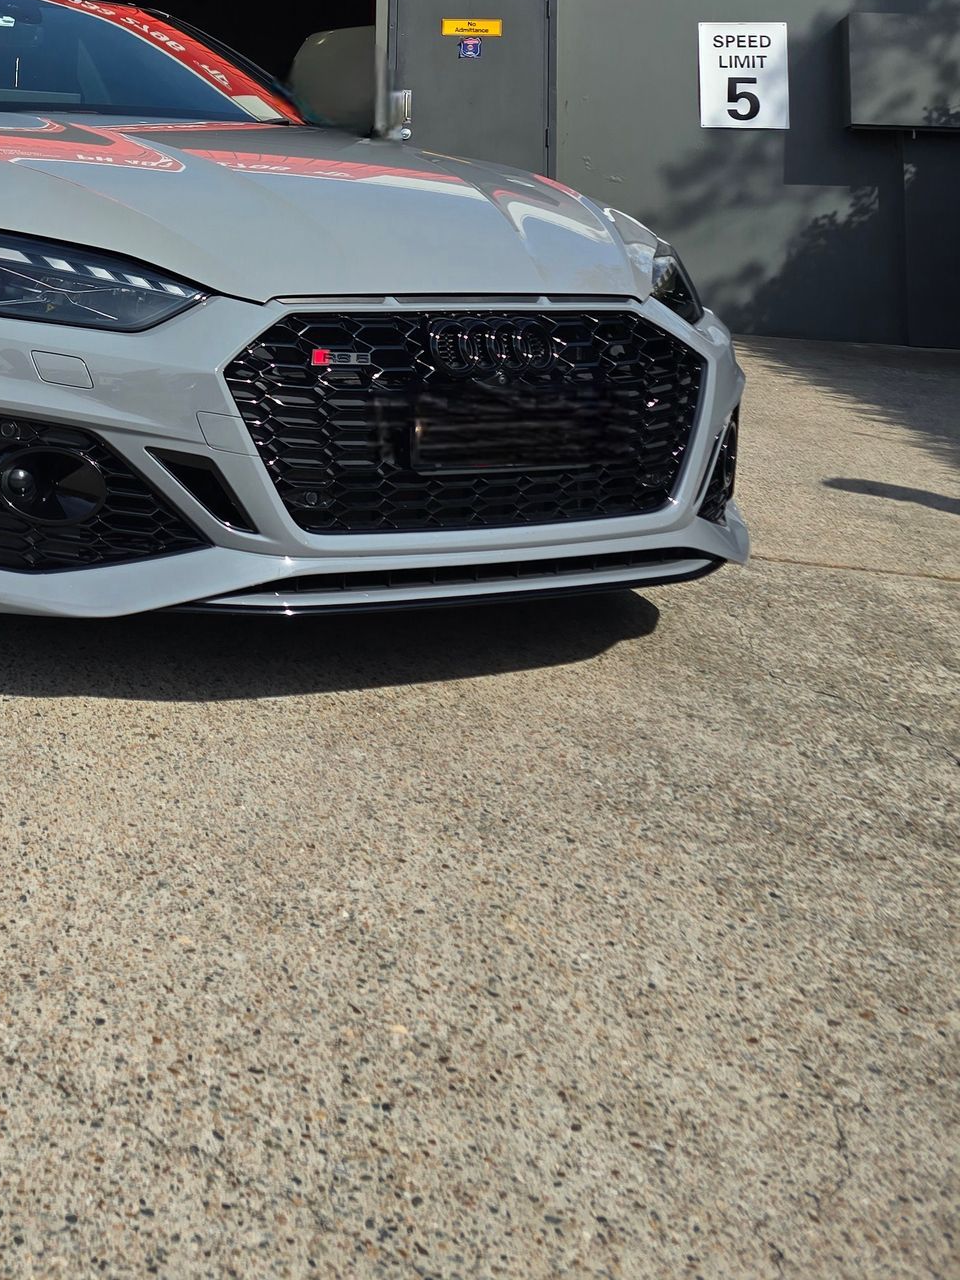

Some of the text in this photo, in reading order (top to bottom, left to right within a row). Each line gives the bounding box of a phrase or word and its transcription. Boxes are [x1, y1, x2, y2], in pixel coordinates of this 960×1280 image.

[712, 35, 772, 48] SPEED
[718, 55, 768, 69] LIMIT
[726, 76, 761, 121] 5
